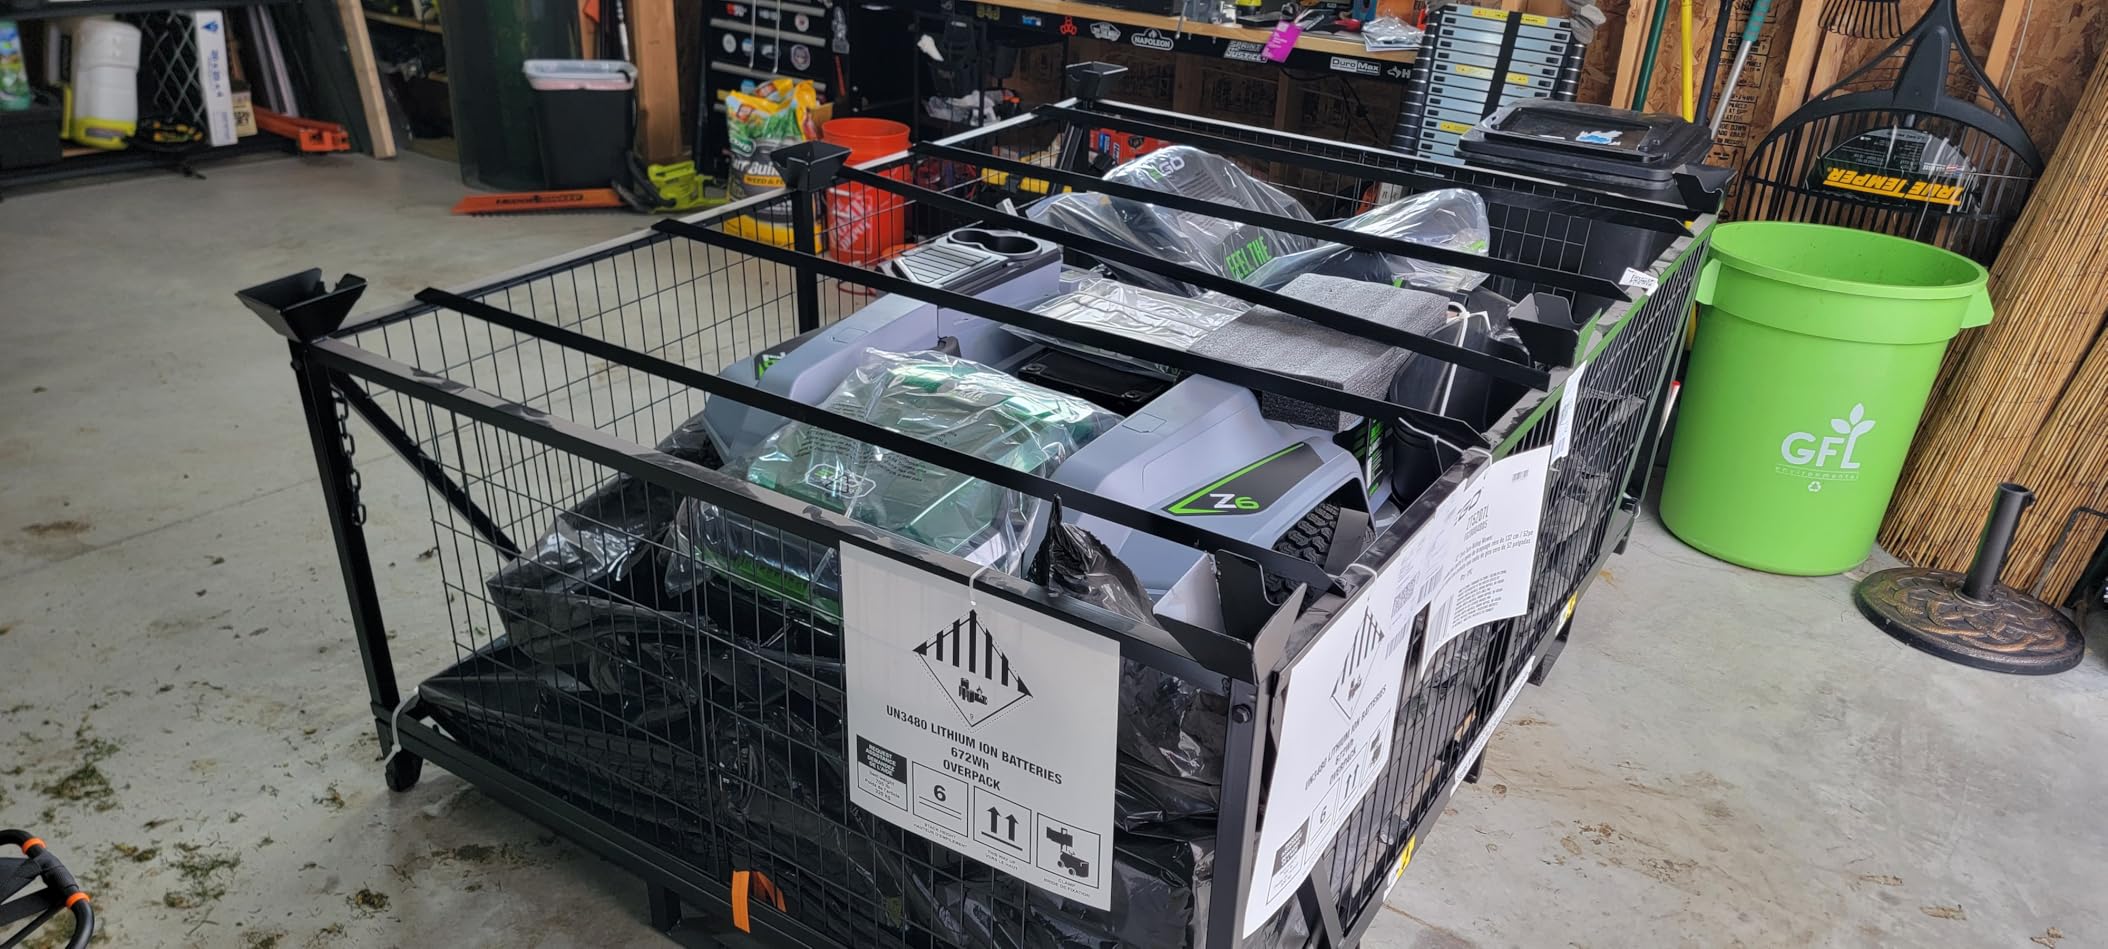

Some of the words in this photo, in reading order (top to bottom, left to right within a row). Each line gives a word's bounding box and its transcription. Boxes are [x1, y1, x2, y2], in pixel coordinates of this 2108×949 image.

[1134, 36, 1171, 48] NAPOLEON
[1823, 167, 1908, 199] TEMPER
[1904, 181, 1965, 207] TRUE
[1226, 247, 1255, 281] FEEL
[1247, 236, 1272, 267] THE
[1781, 420, 1874, 468] GFL
[1209, 493, 1260, 510] Z6
[886, 704, 927, 730] UN3480
[931, 722, 976, 749] LITHIUM
[979, 741, 998, 758] ION
[1002, 751, 1062, 785] BATTERIES
[951, 747, 989, 770] 672Wh
[943, 759, 1001, 790] OVERPACK
[933, 785, 947, 802] 6
[1320, 805, 1327, 823] 6
